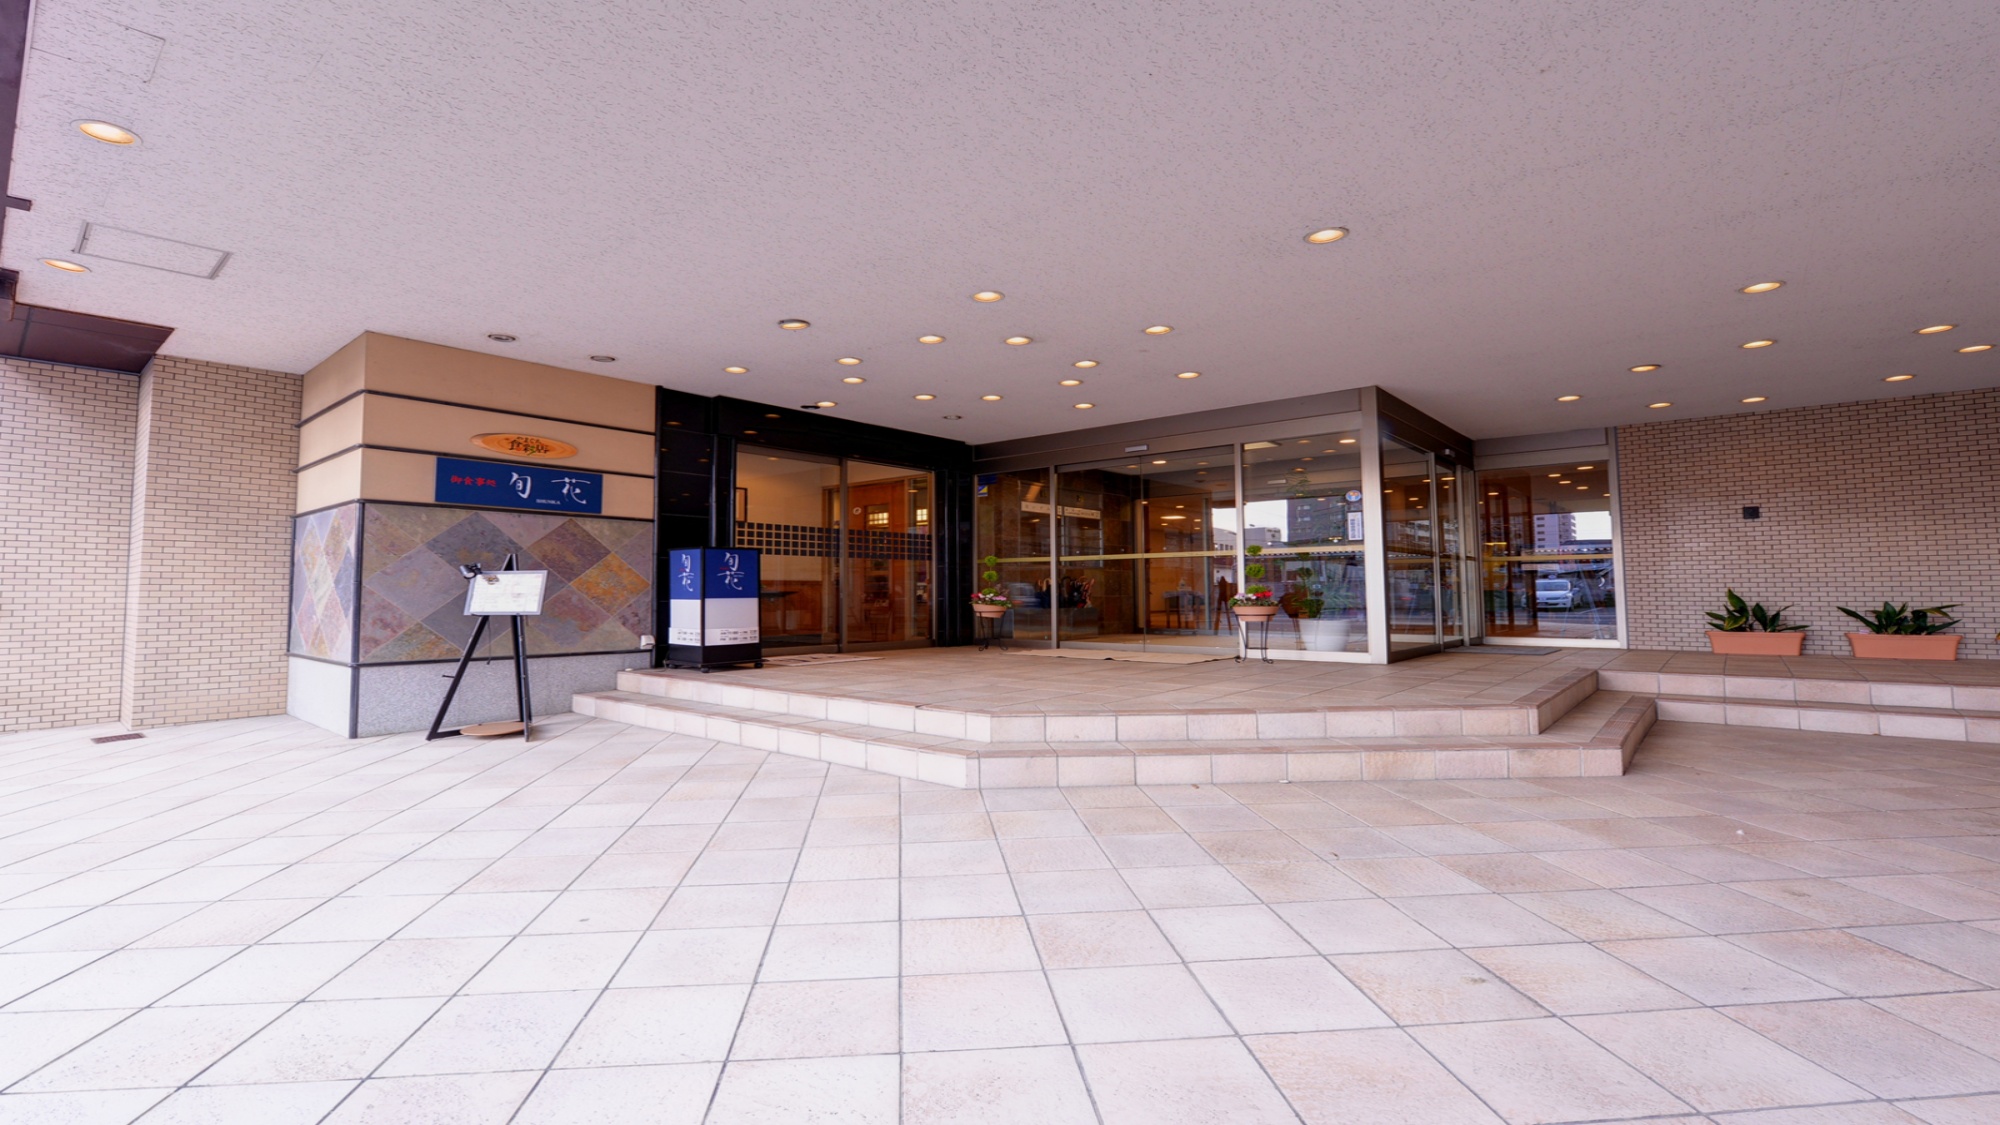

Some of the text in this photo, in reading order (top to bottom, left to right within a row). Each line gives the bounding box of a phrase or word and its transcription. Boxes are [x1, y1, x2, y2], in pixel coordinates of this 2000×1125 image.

[450, 472, 591, 505] 御食事処 旬花
[678, 553, 694, 592] 旬花
[717, 552, 745, 590] 旬花
